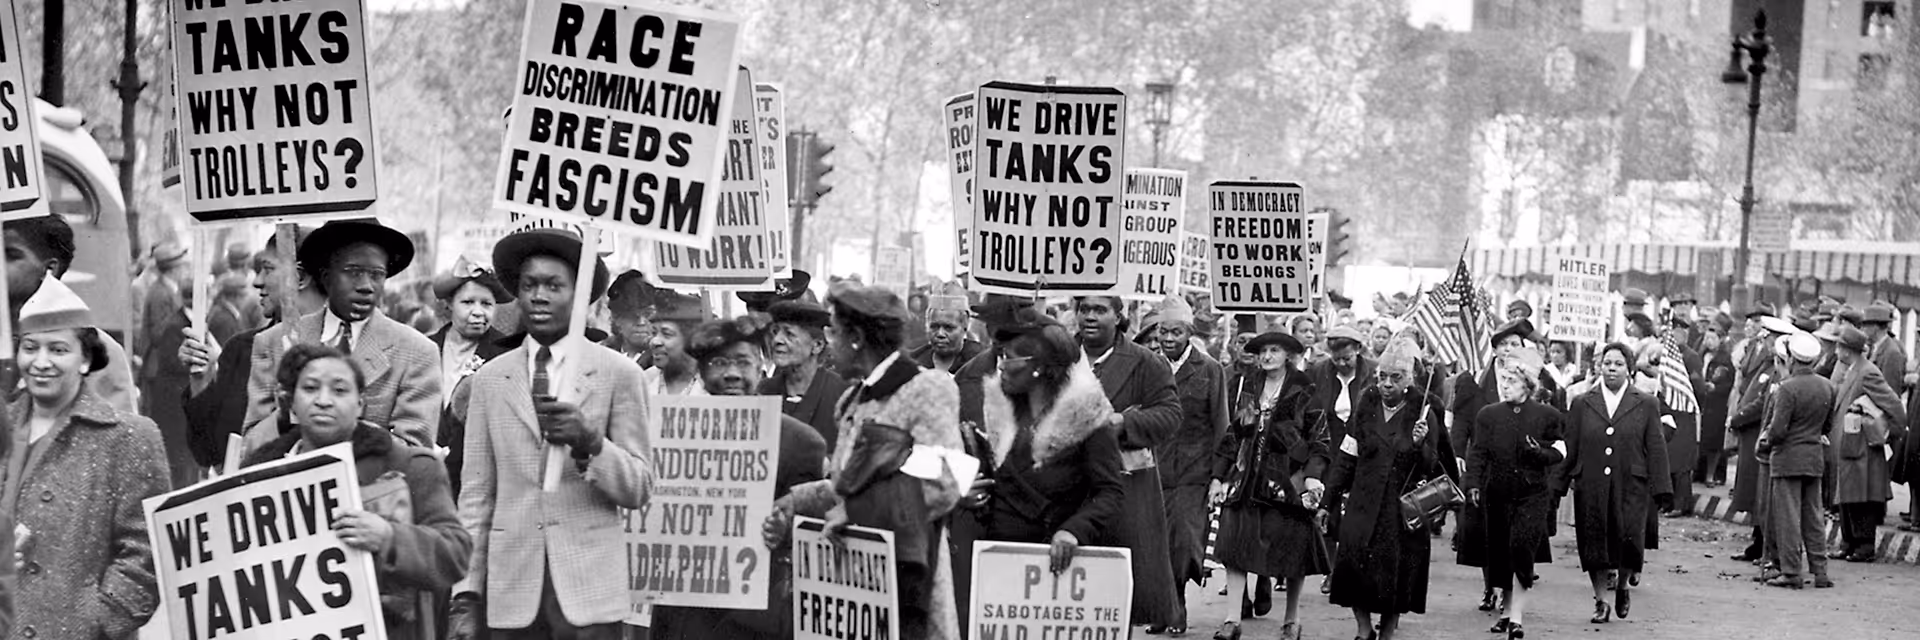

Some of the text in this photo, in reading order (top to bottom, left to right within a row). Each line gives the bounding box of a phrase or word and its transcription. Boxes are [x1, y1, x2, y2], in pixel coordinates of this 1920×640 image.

[186, 11, 350, 75] TANKS
[552, 2, 703, 76] RACE
[188, 80, 357, 135] WHY NOT
[523, 60, 721, 126] DISCRIMINATION
[731, 119, 749, 134] HE
[986, 96, 1022, 132] WE
[1035, 102, 1118, 136] DRIVE
[529, 107, 693, 168] BREEDS
[190, 137, 364, 200] TROLLEYS?
[986, 138, 1112, 184] TANKS
[506, 148, 705, 235] FASCISM
[1125, 174, 1182, 198] MINATION
[1212, 191, 1300, 213] IN DEMOCRACY
[983, 189, 1037, 226] WHY
[1048, 195, 1114, 228] NOT
[1125, 215, 1177, 234] GROUP
[1213, 217, 1301, 239] FREEDOM
[686, 235, 765, 269] WORK!
[980, 230, 1112, 275] TROLLEYS?
[1214, 243, 1239, 260] TO
[1244, 243, 1303, 262] WORK
[1559, 259, 1606, 277] HITLER
[1134, 273, 1167, 295] ALL
[1222, 265, 1296, 279] BELONGS
[1218, 282, 1241, 302] TO
[1250, 282, 1304, 304] ALL!
[661, 407, 761, 440] MOTORMEN
[651, 447, 768, 482] NDUCTORS
[166, 478, 339, 571] WE DRIVE
[660, 503, 713, 536] NOT
[722, 505, 747, 537] IN
[798, 540, 811, 579] IN
[178, 546, 352, 640] TANKS
[800, 591, 889, 640] FREEDOM
[983, 603, 1120, 622] SABOTAGES THE
